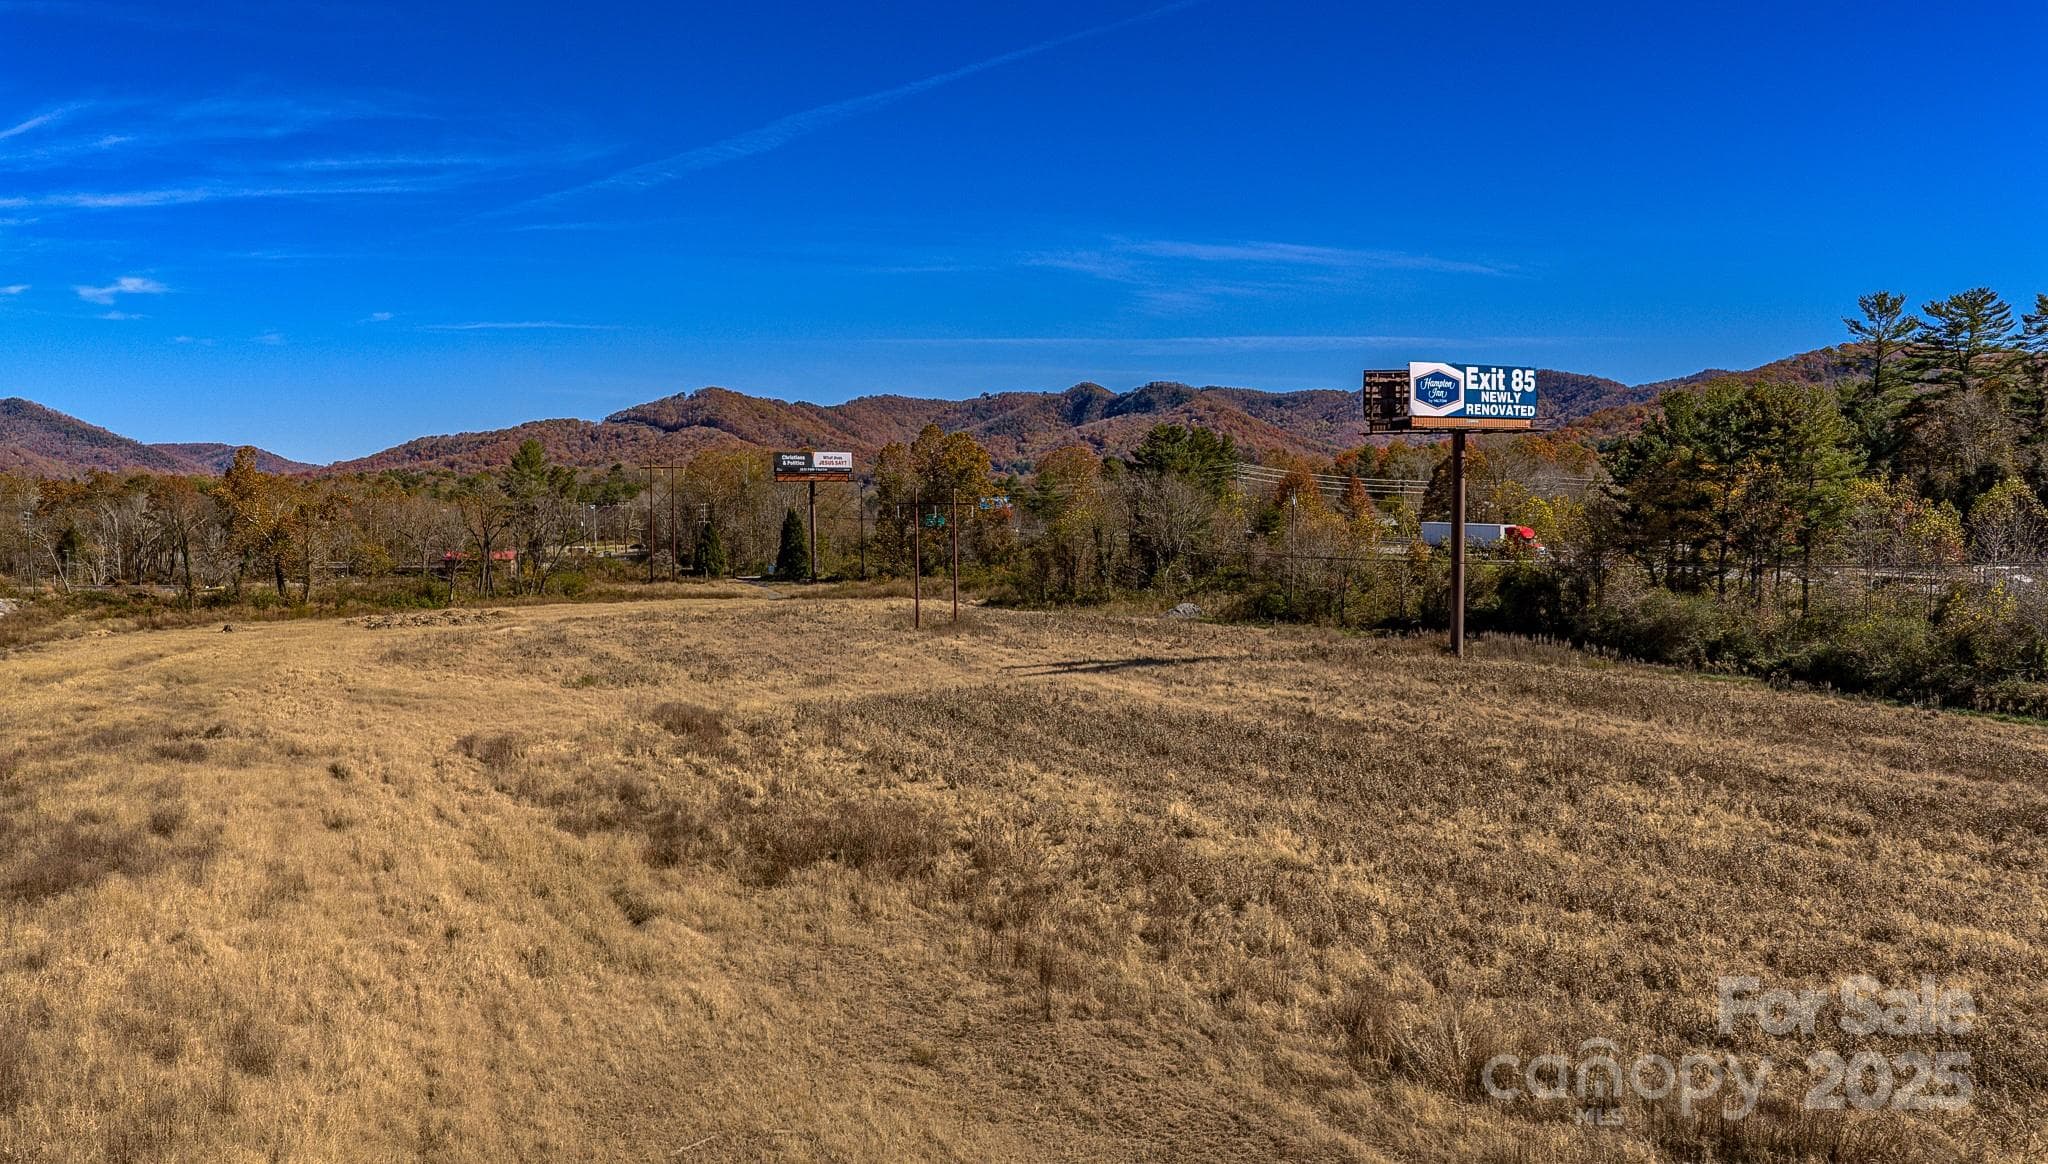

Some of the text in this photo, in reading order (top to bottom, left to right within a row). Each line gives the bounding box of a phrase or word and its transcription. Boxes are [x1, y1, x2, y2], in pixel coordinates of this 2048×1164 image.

[1420, 378, 1455, 390] Hampton
[1466, 367, 1536, 392] Exit 85
[1428, 388, 1447, 398] Inn
[1481, 392, 1521, 403] NEWLY
[1466, 405, 1536, 417] RENOVATED
